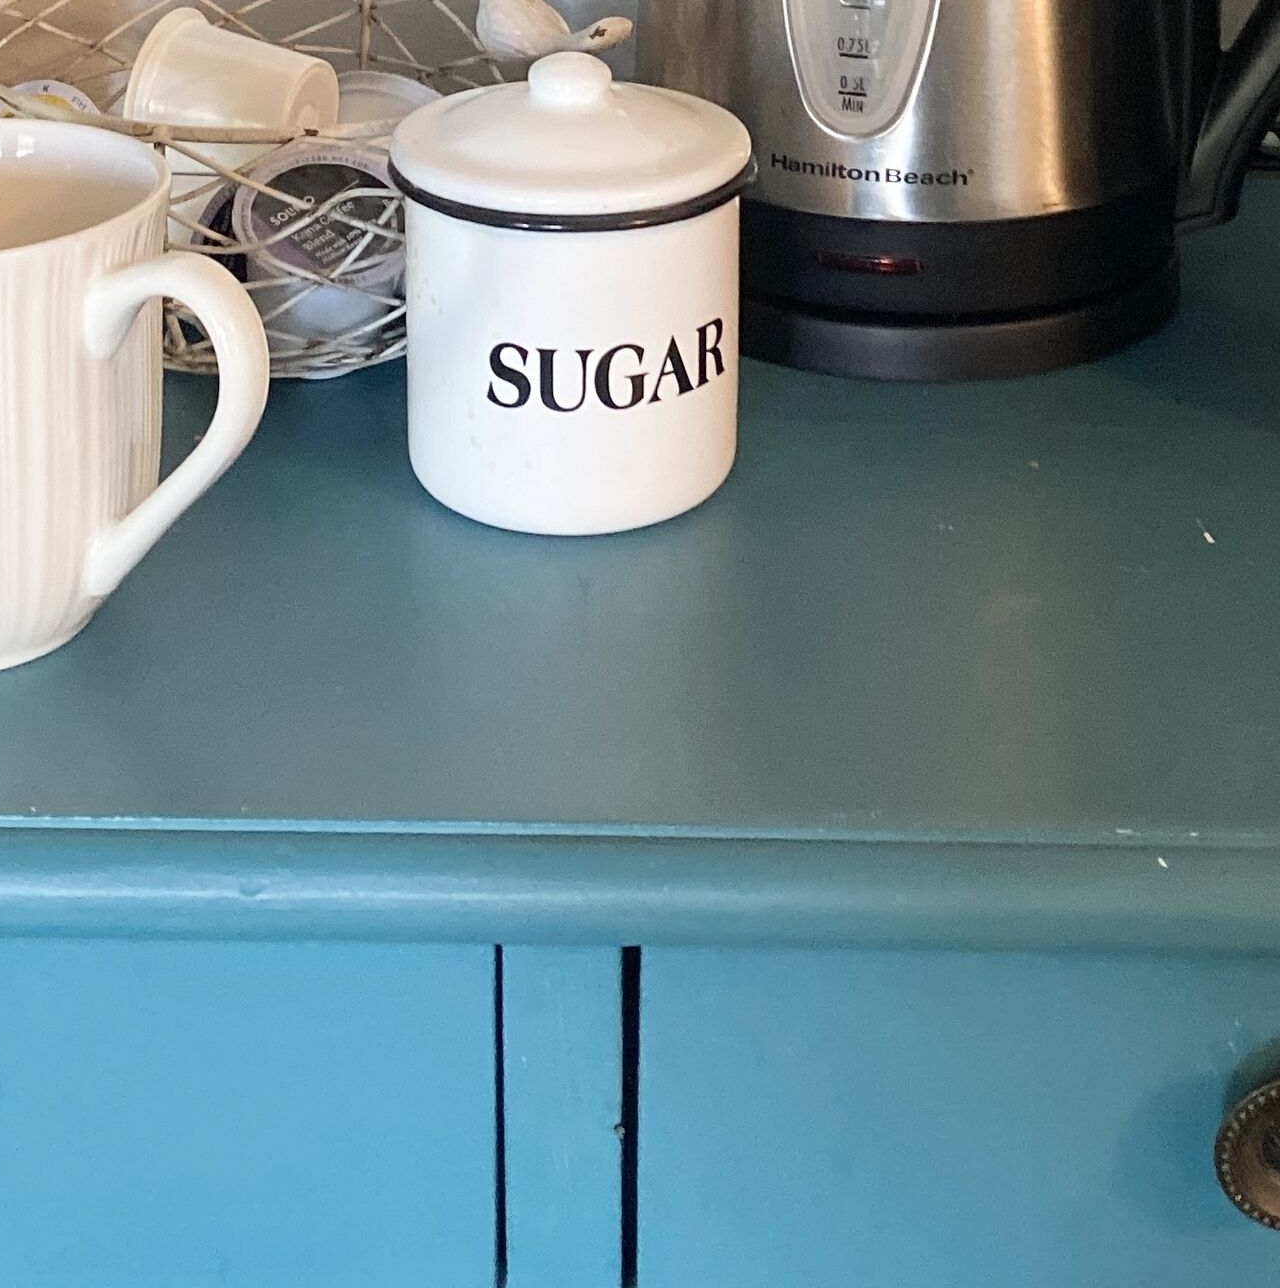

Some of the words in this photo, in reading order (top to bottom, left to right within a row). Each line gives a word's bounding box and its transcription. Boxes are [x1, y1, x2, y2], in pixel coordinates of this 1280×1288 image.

[770, 153, 880, 182] Hamilton
[885, 168, 969, 185] Beach
[486, 317, 725, 412] SUGAR
